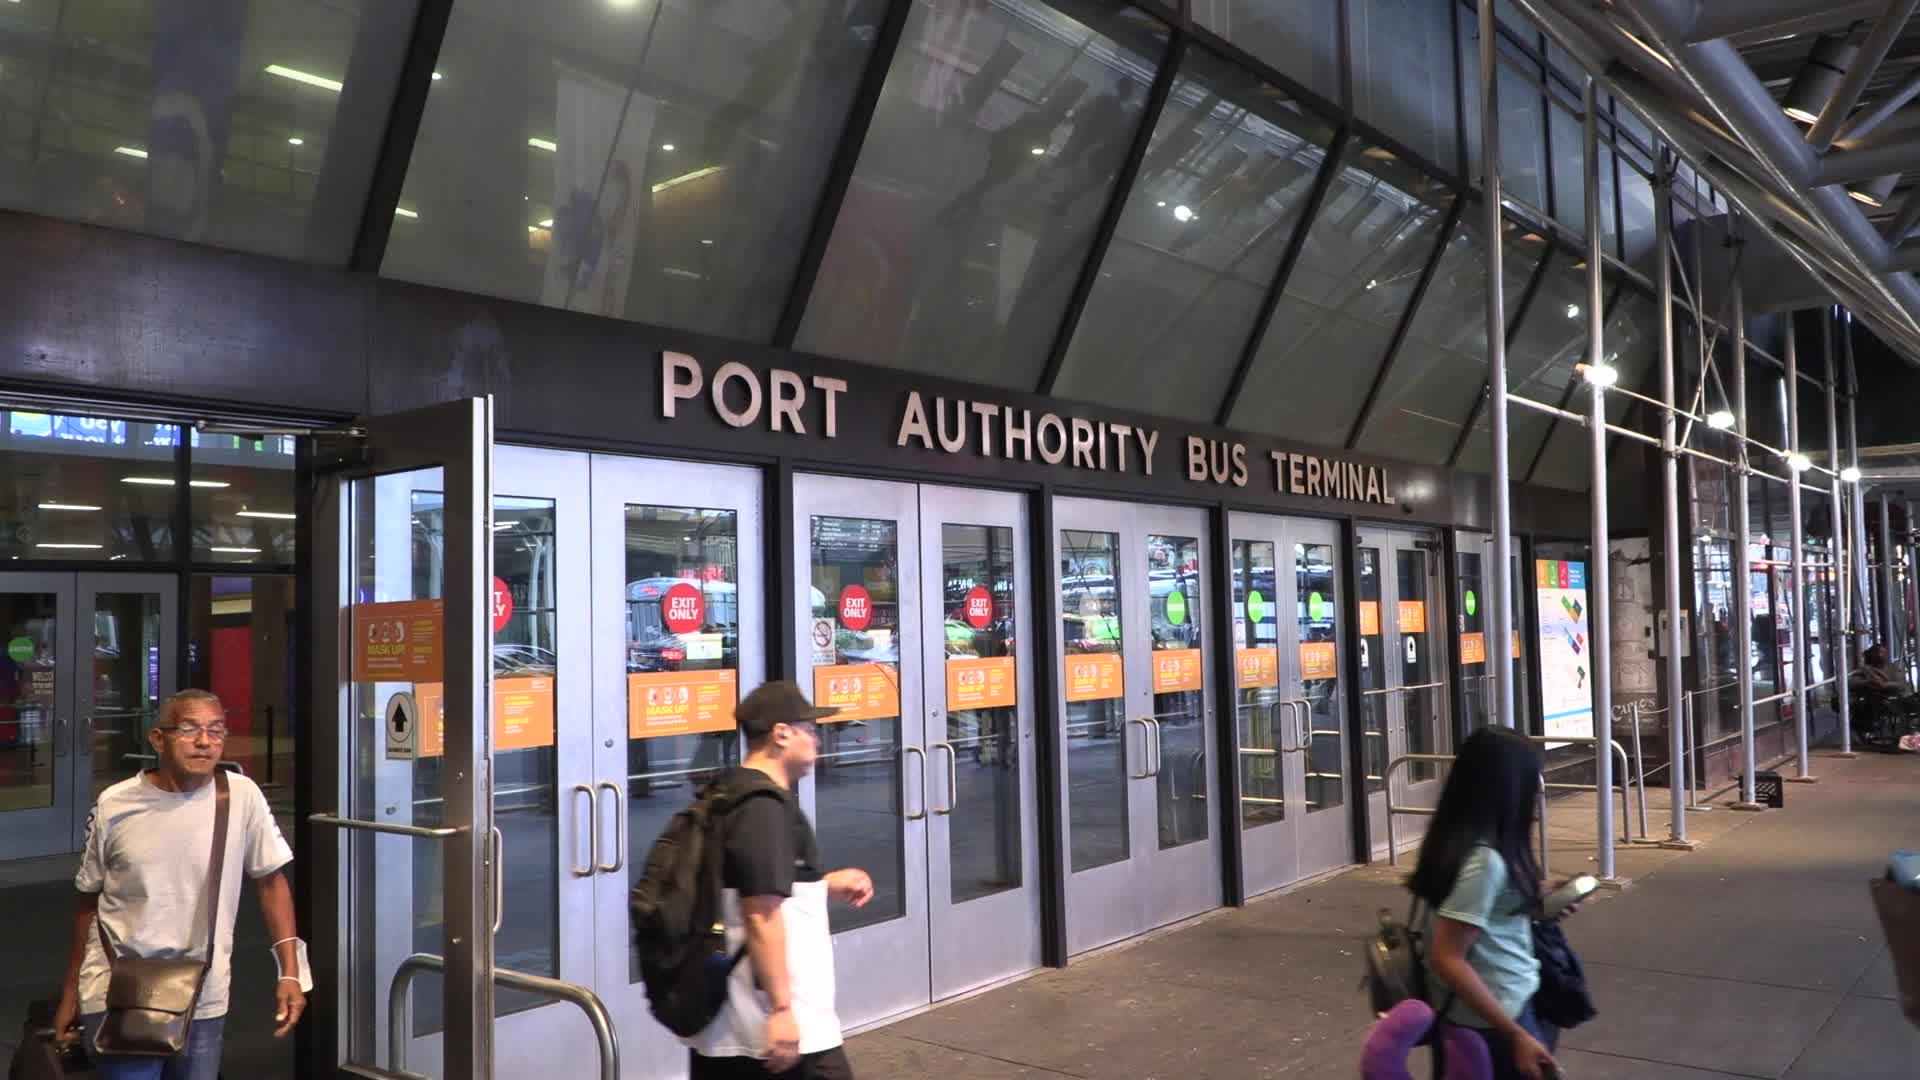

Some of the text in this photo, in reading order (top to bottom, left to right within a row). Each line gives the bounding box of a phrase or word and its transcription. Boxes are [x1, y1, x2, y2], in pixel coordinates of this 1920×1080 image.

[661, 350, 1396, 504] PORT AUTHORITY BUS TERMINAL
[671, 597, 697, 609] EXIT
[845, 597, 866, 608] EXIT
[970, 598, 988, 608] EXIT
[668, 608, 699, 620] ONLY
[843, 607, 868, 618] ONLY
[969, 607, 990, 617] ONLY
